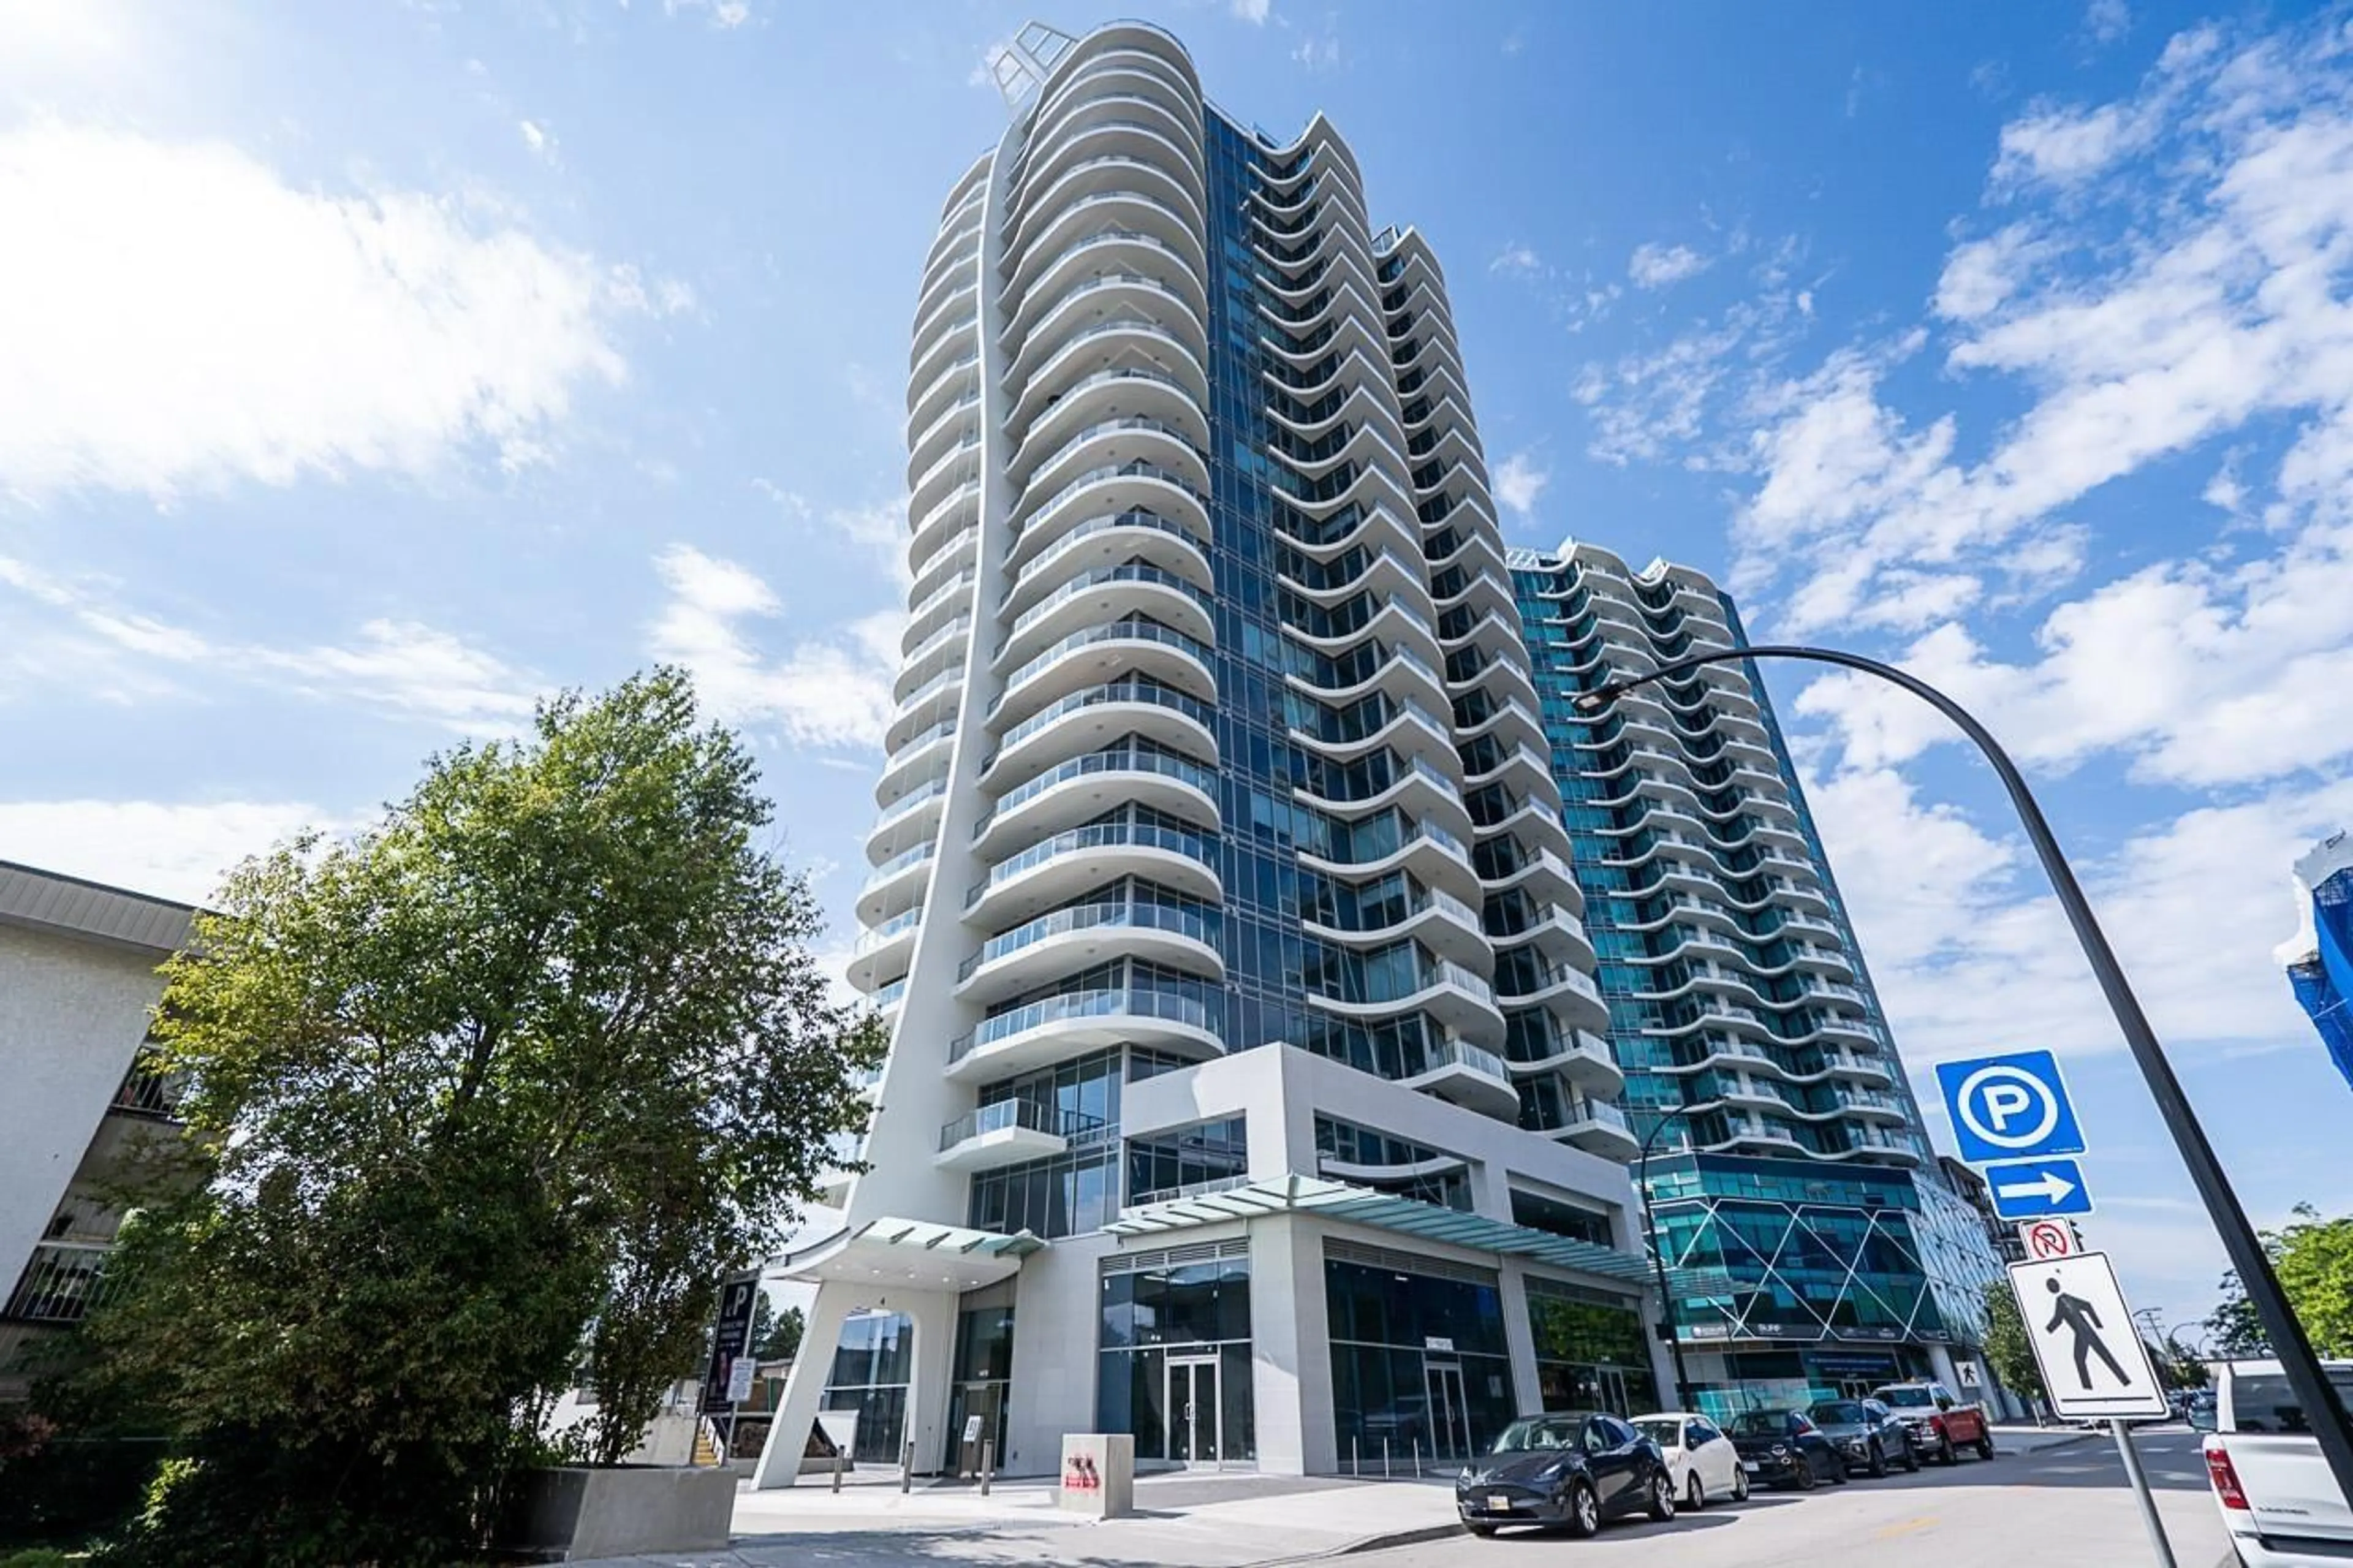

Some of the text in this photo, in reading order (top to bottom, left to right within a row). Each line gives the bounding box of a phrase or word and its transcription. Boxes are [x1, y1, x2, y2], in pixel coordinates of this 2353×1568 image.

[1982, 1085, 2030, 1131] P
[2042, 1233, 2056, 1254] P
[733, 1285, 748, 1316] P
